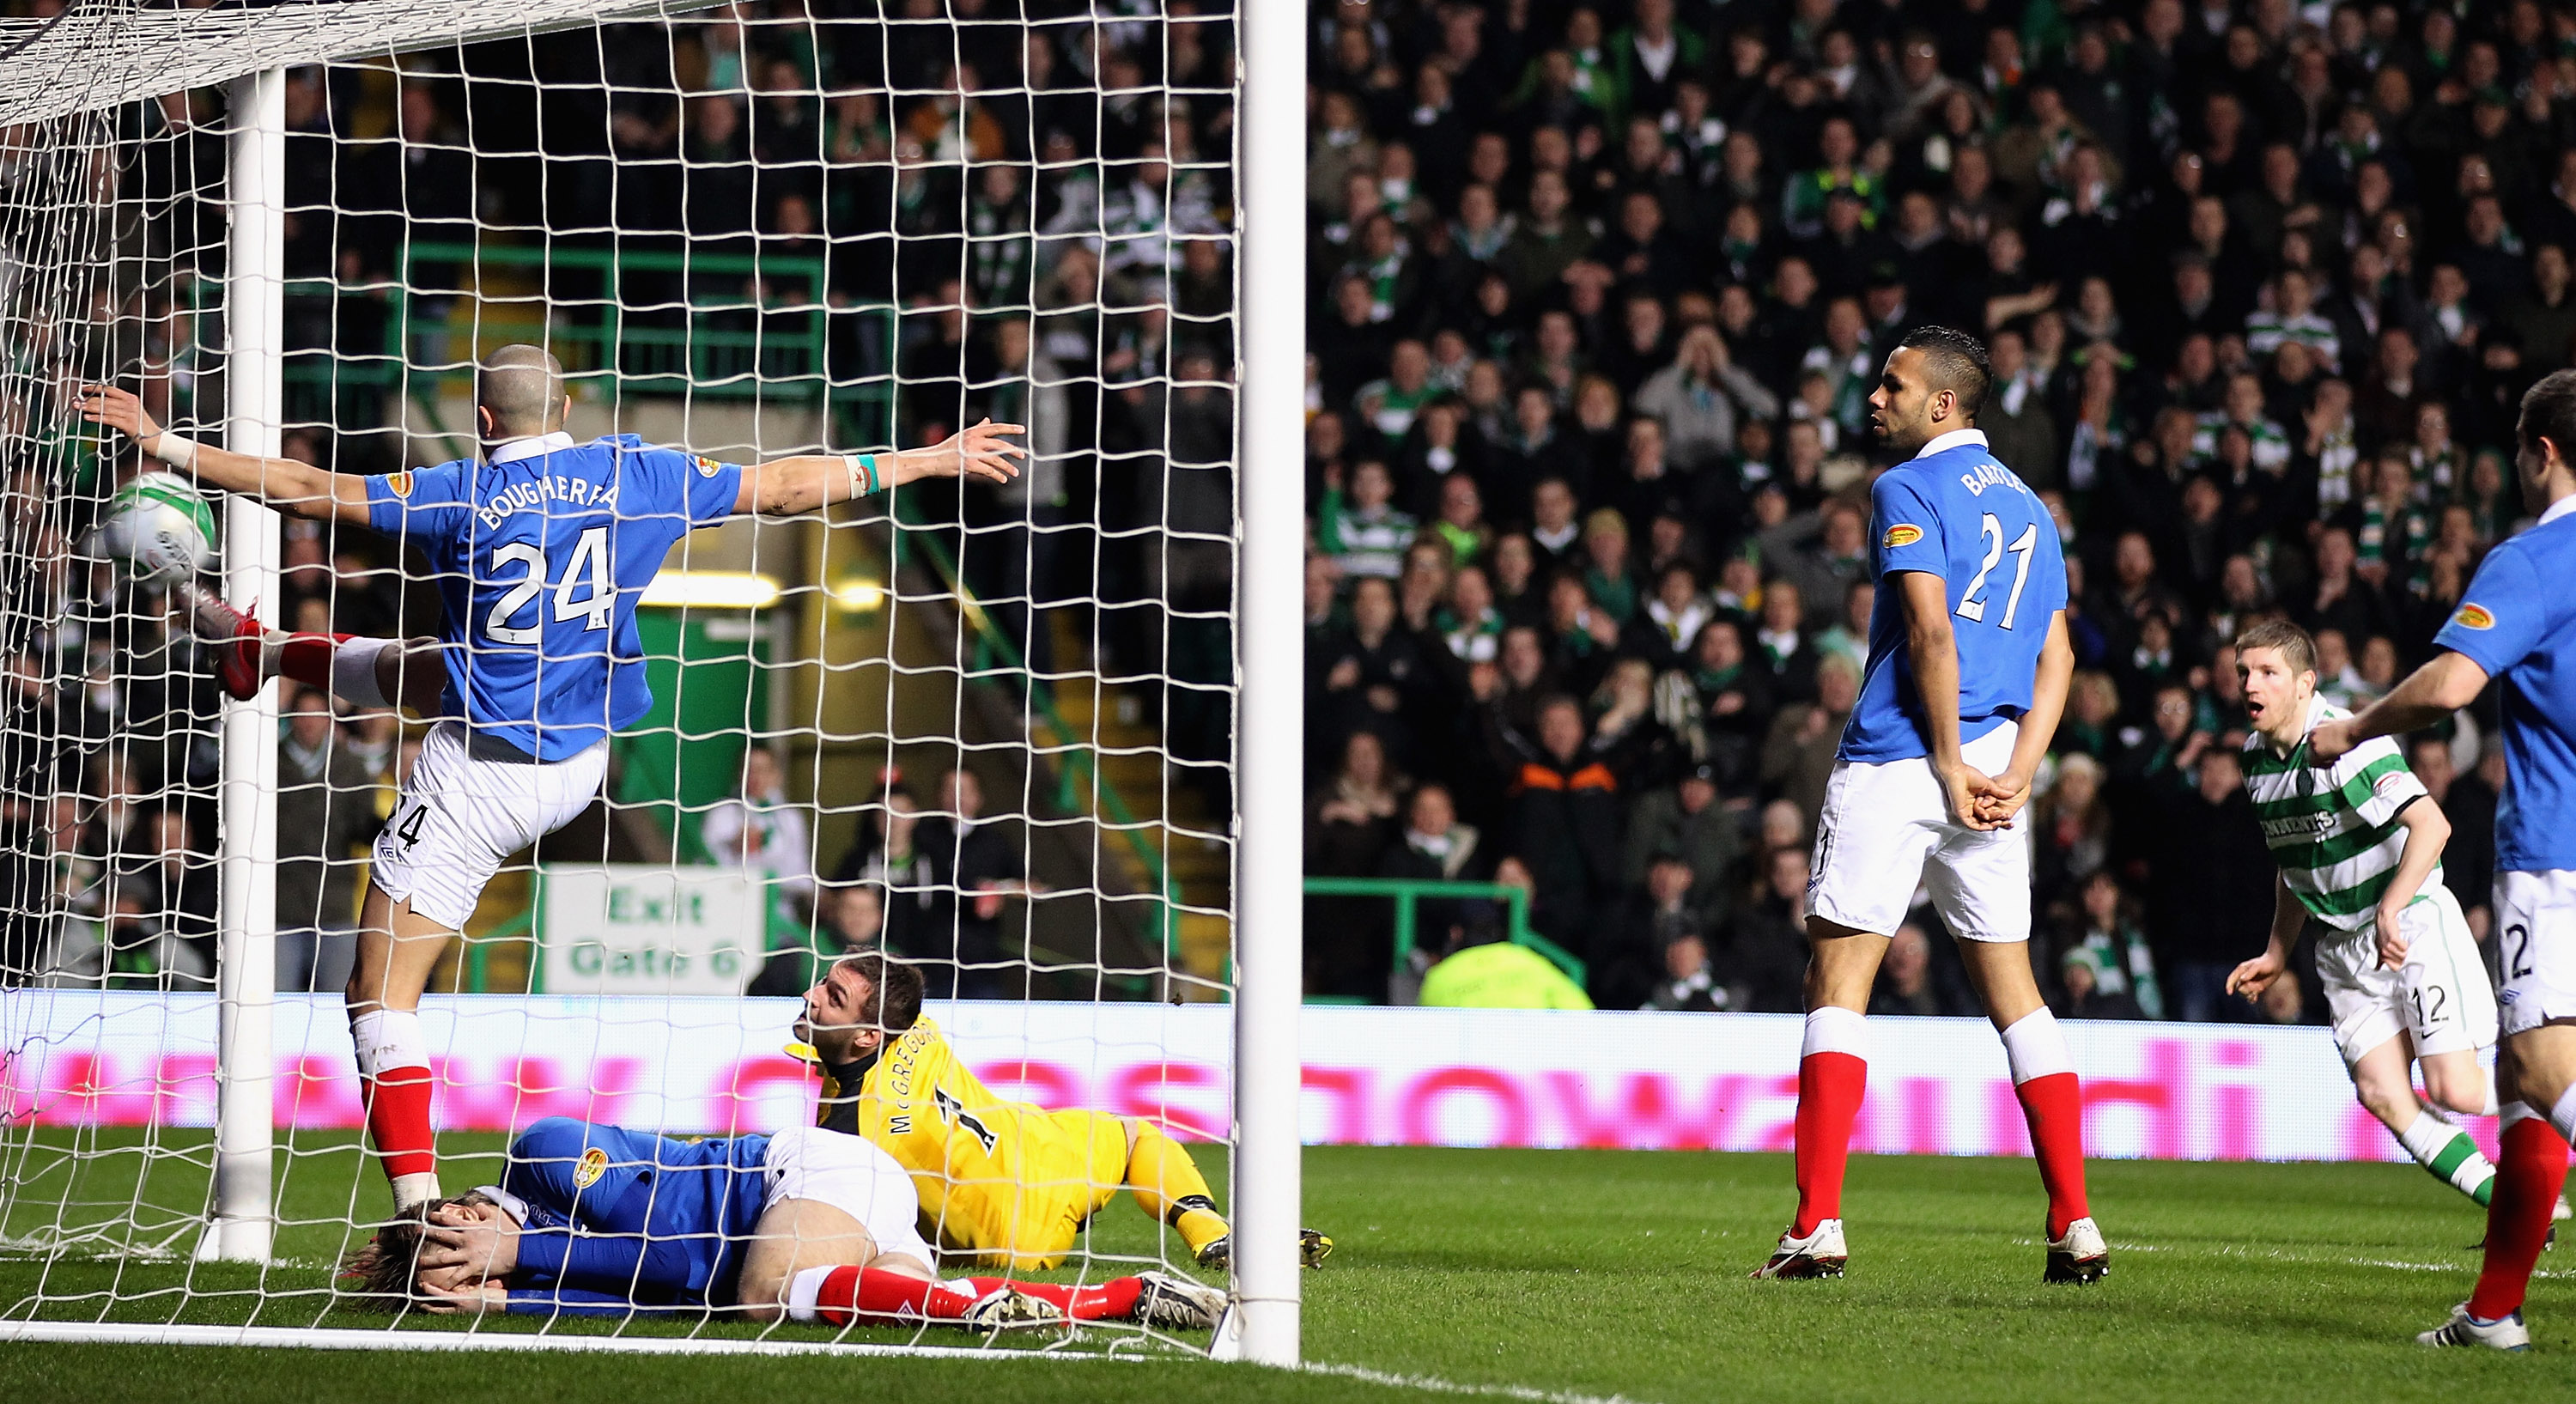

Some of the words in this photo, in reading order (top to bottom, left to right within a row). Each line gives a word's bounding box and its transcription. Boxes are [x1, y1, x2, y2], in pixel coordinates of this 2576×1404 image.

[1959, 464, 2027, 497] BARTLE
[485, 525, 621, 645] 24
[1953, 511, 2038, 631] 21
[606, 885, 704, 925] Exit
[568, 938, 688, 977] Gate
[710, 940, 740, 977] 6
[2411, 985, 2450, 1026] 12
[933, 1079, 999, 1159] 1
